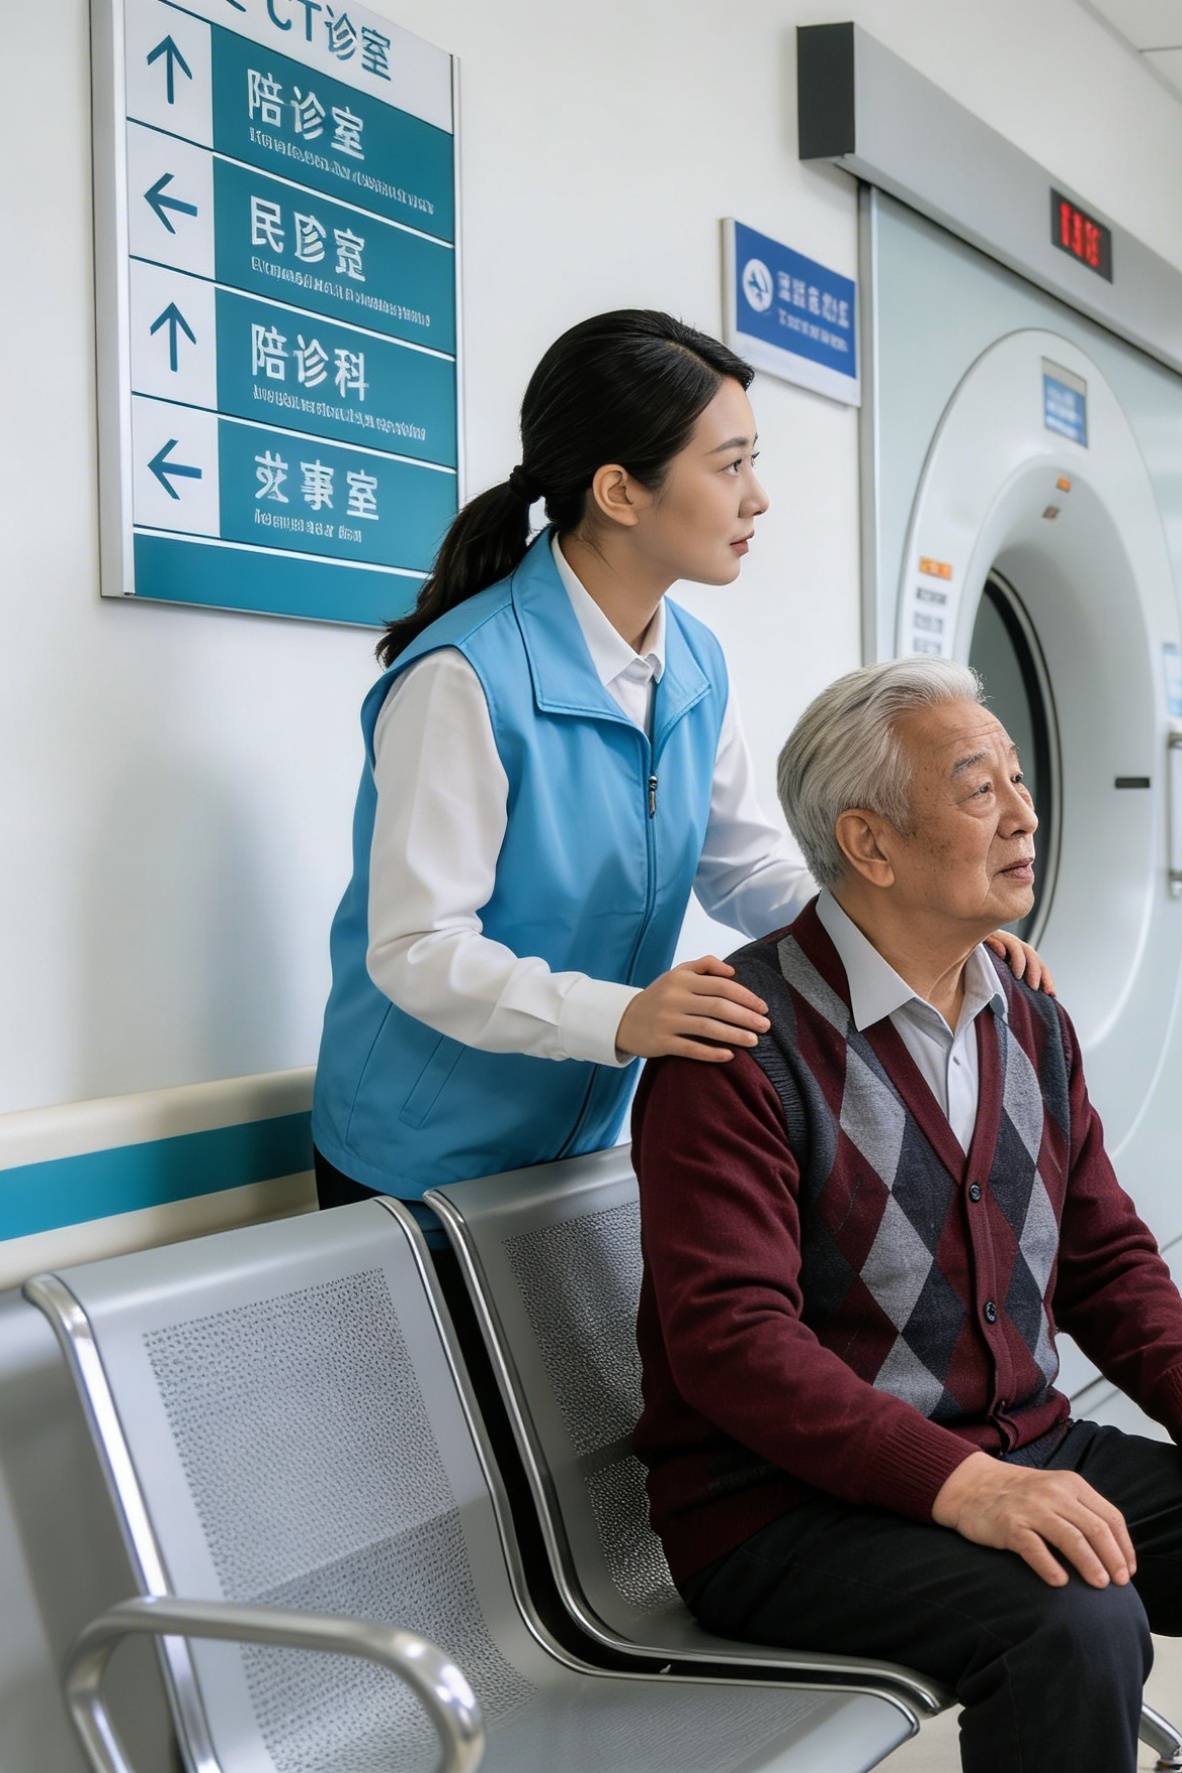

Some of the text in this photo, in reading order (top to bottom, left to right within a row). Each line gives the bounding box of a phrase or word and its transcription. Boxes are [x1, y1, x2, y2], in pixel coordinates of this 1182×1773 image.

[247, 68, 365, 161] 陪诊室
[251, 323, 370, 401] 陪诊科
